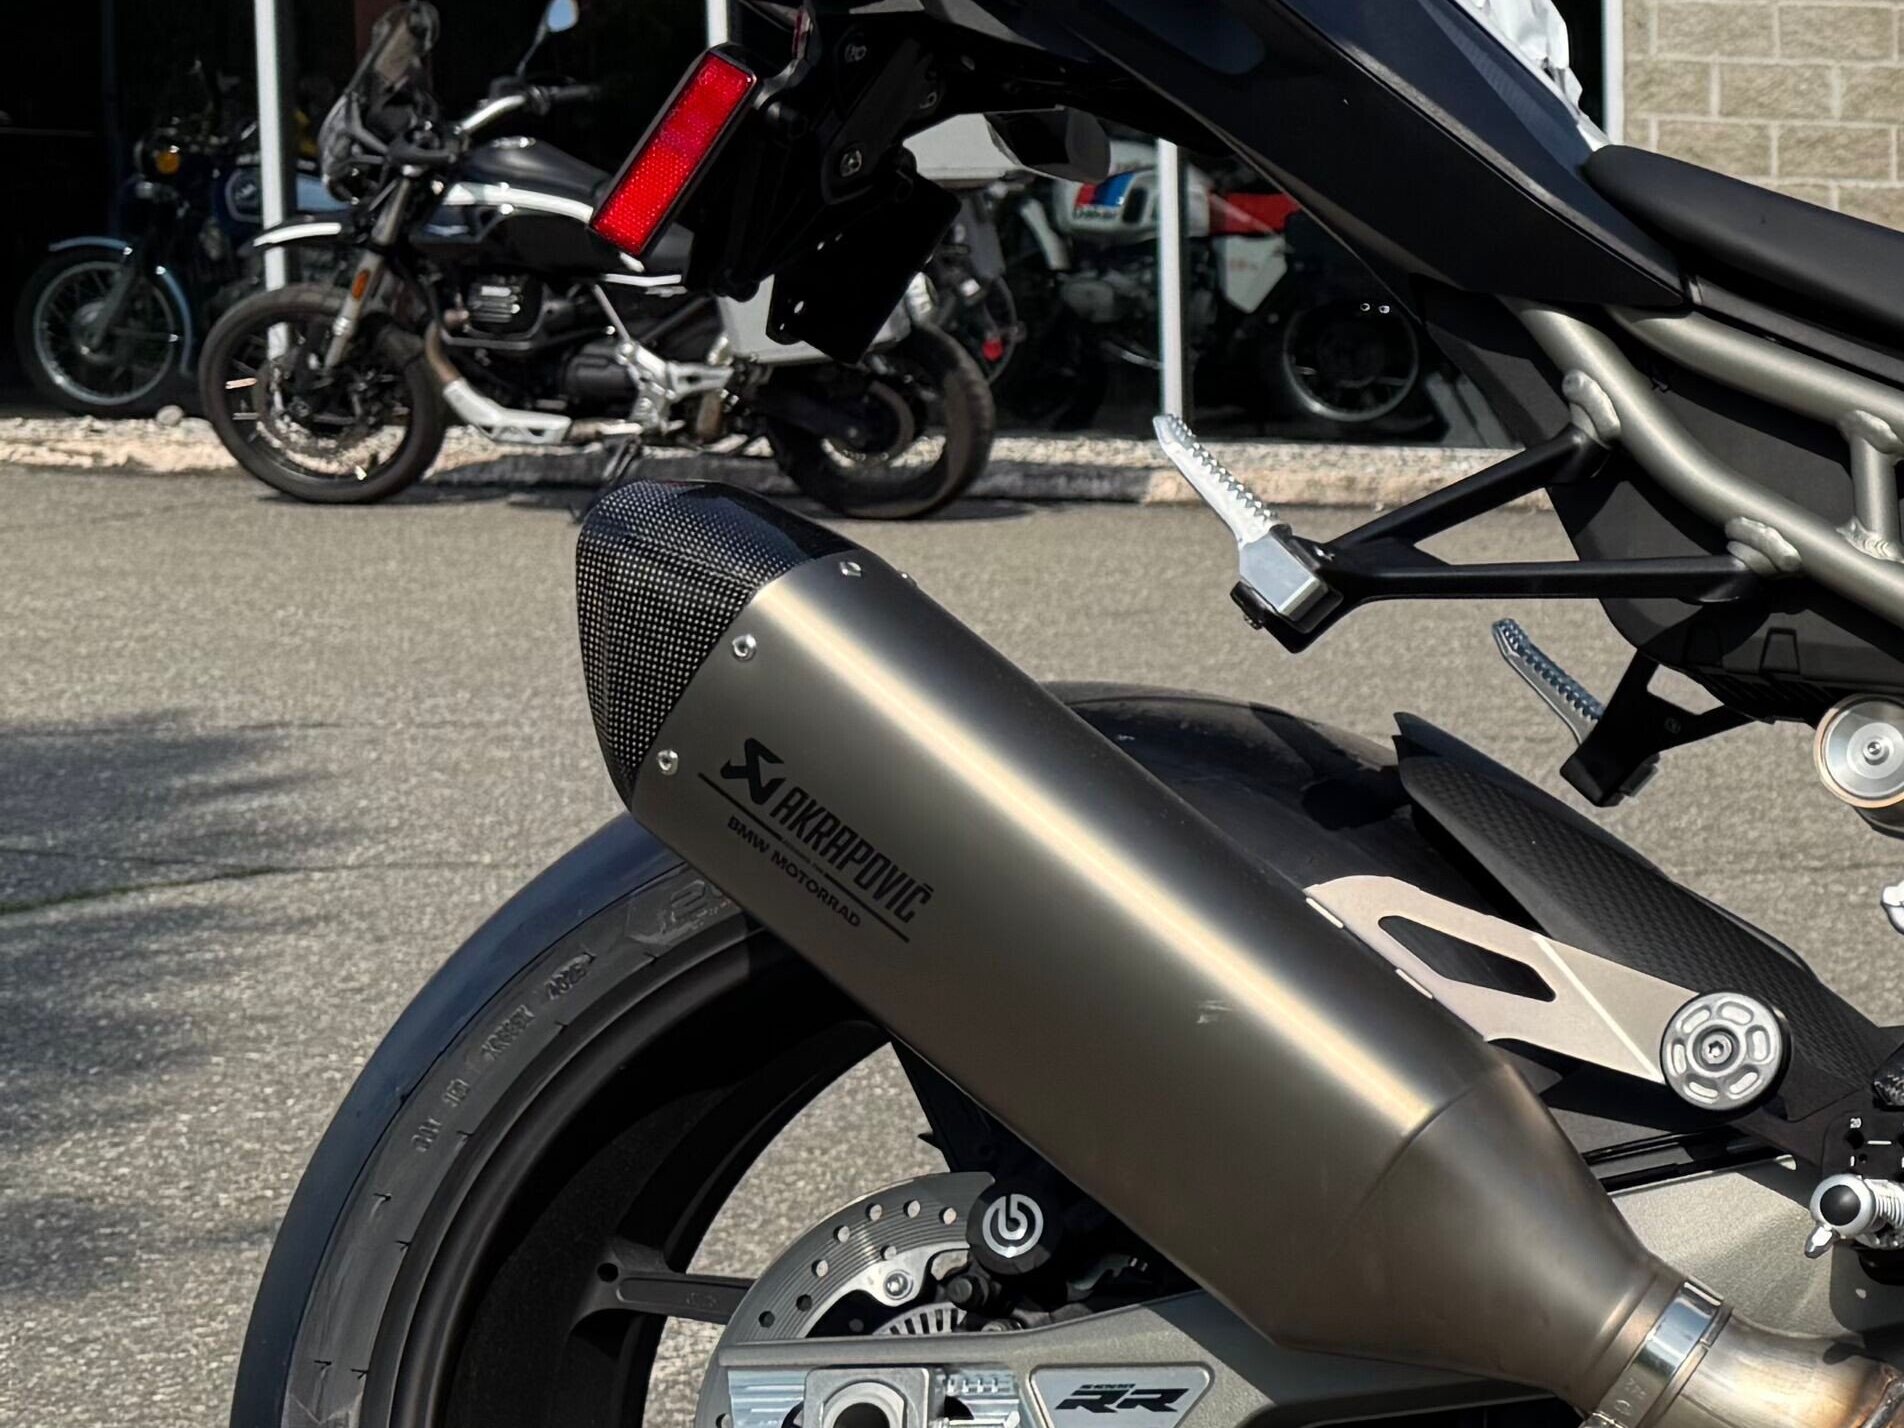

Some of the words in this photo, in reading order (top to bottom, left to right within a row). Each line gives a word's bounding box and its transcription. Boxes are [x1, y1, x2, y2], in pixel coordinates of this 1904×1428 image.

[727, 815, 770, 855] BMW
[770, 848, 861, 928] MOTORRAD
[769, 785, 935, 925] AKRAPOVIČ
[1055, 1387, 1190, 1414] RR
